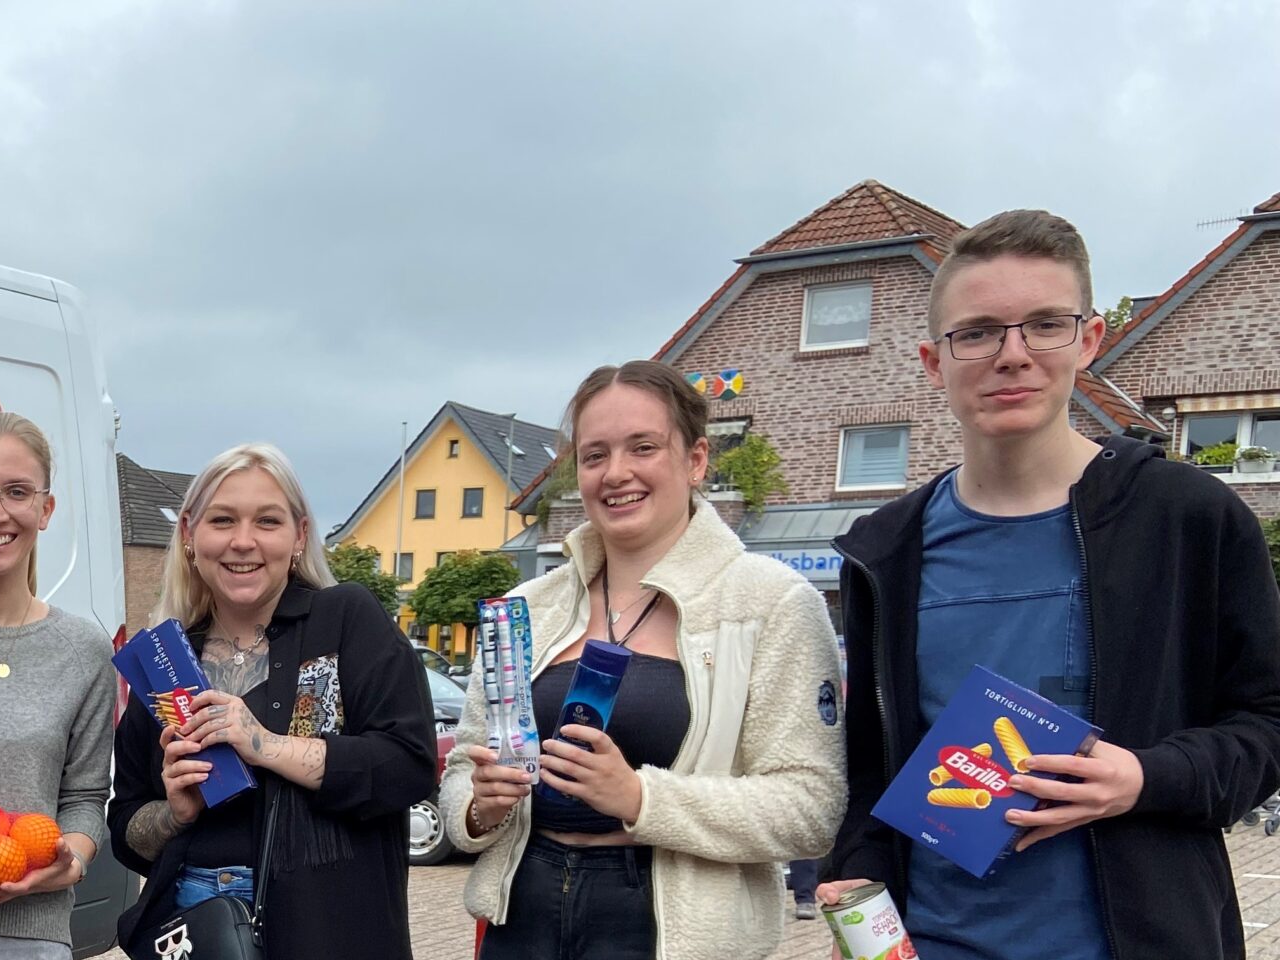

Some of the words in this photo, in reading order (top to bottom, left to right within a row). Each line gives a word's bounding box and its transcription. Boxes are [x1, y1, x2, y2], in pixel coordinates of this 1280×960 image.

[150, 632, 180, 687] SPAGHETTONI
[984, 687, 1037, 721] TORTIGLIONI
[945, 751, 1008, 792] Barilla
